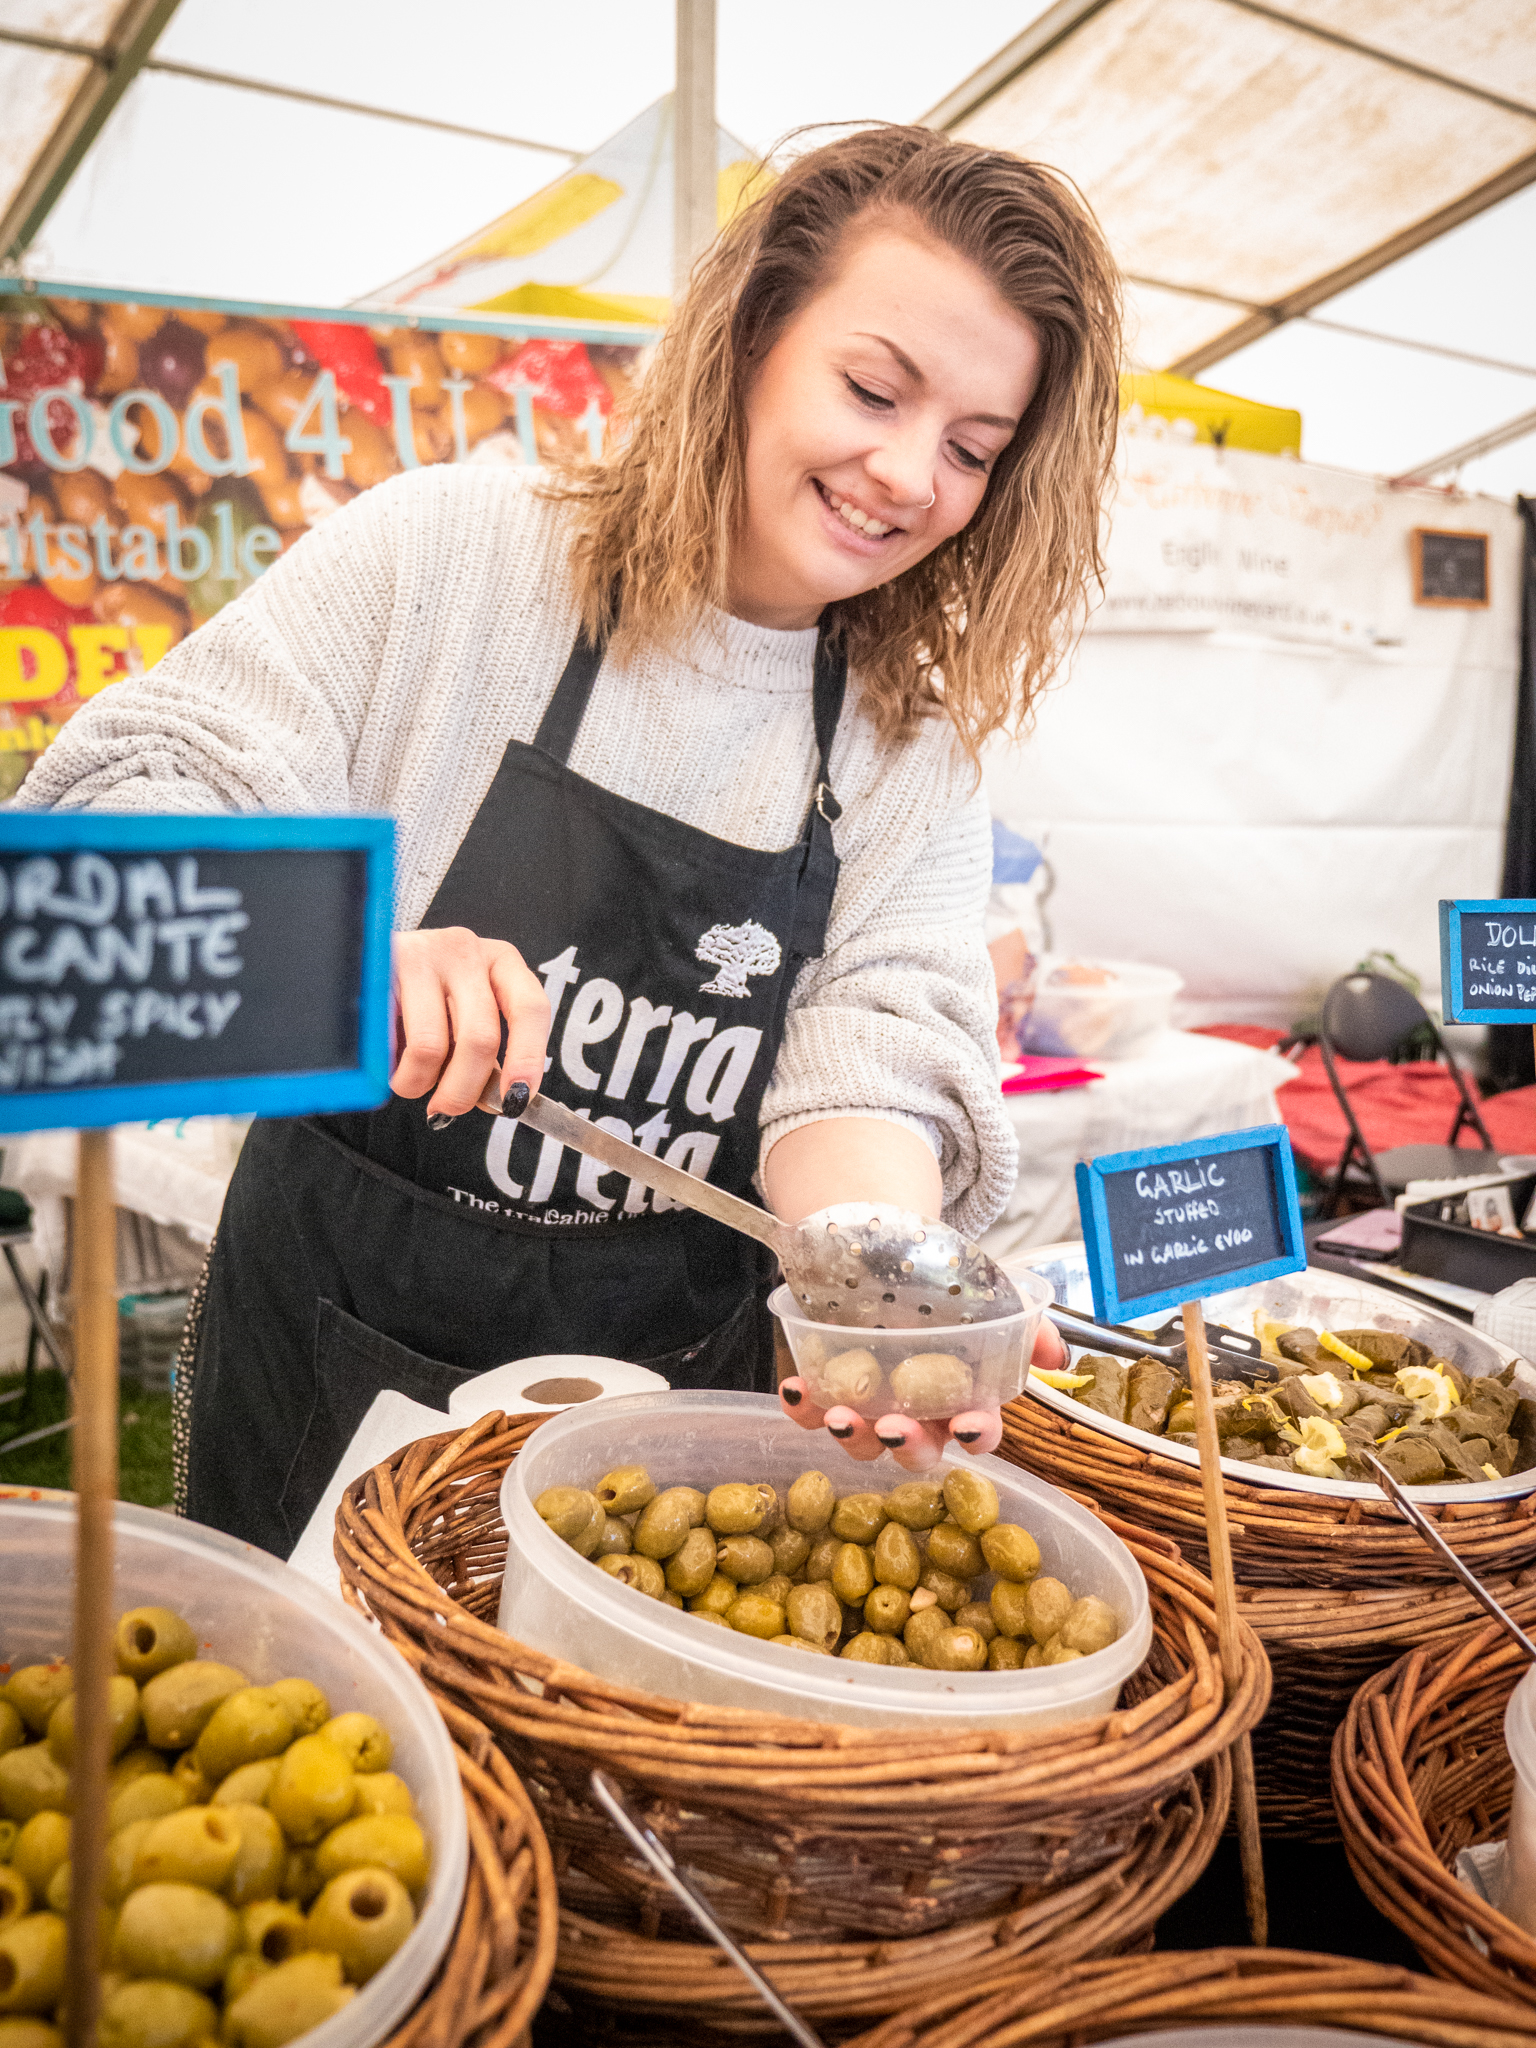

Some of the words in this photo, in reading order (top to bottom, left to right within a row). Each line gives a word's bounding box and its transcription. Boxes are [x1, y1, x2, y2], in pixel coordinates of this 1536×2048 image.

[0, 361, 264, 477] ood
[285, 370, 351, 479] 4
[0, 854, 244, 924] RDAL
[1, 910, 248, 985] CANTE
[1485, 922, 1536, 948] DOL
[1469, 978, 1513, 996] ONION
[538, 945, 763, 1122] terra
[448, 1186, 500, 1213] The
[1153, 1198, 1219, 1225] STUFFED
[1123, 1248, 1144, 1266] IN
[1214, 1228, 1253, 1251] EVOO
